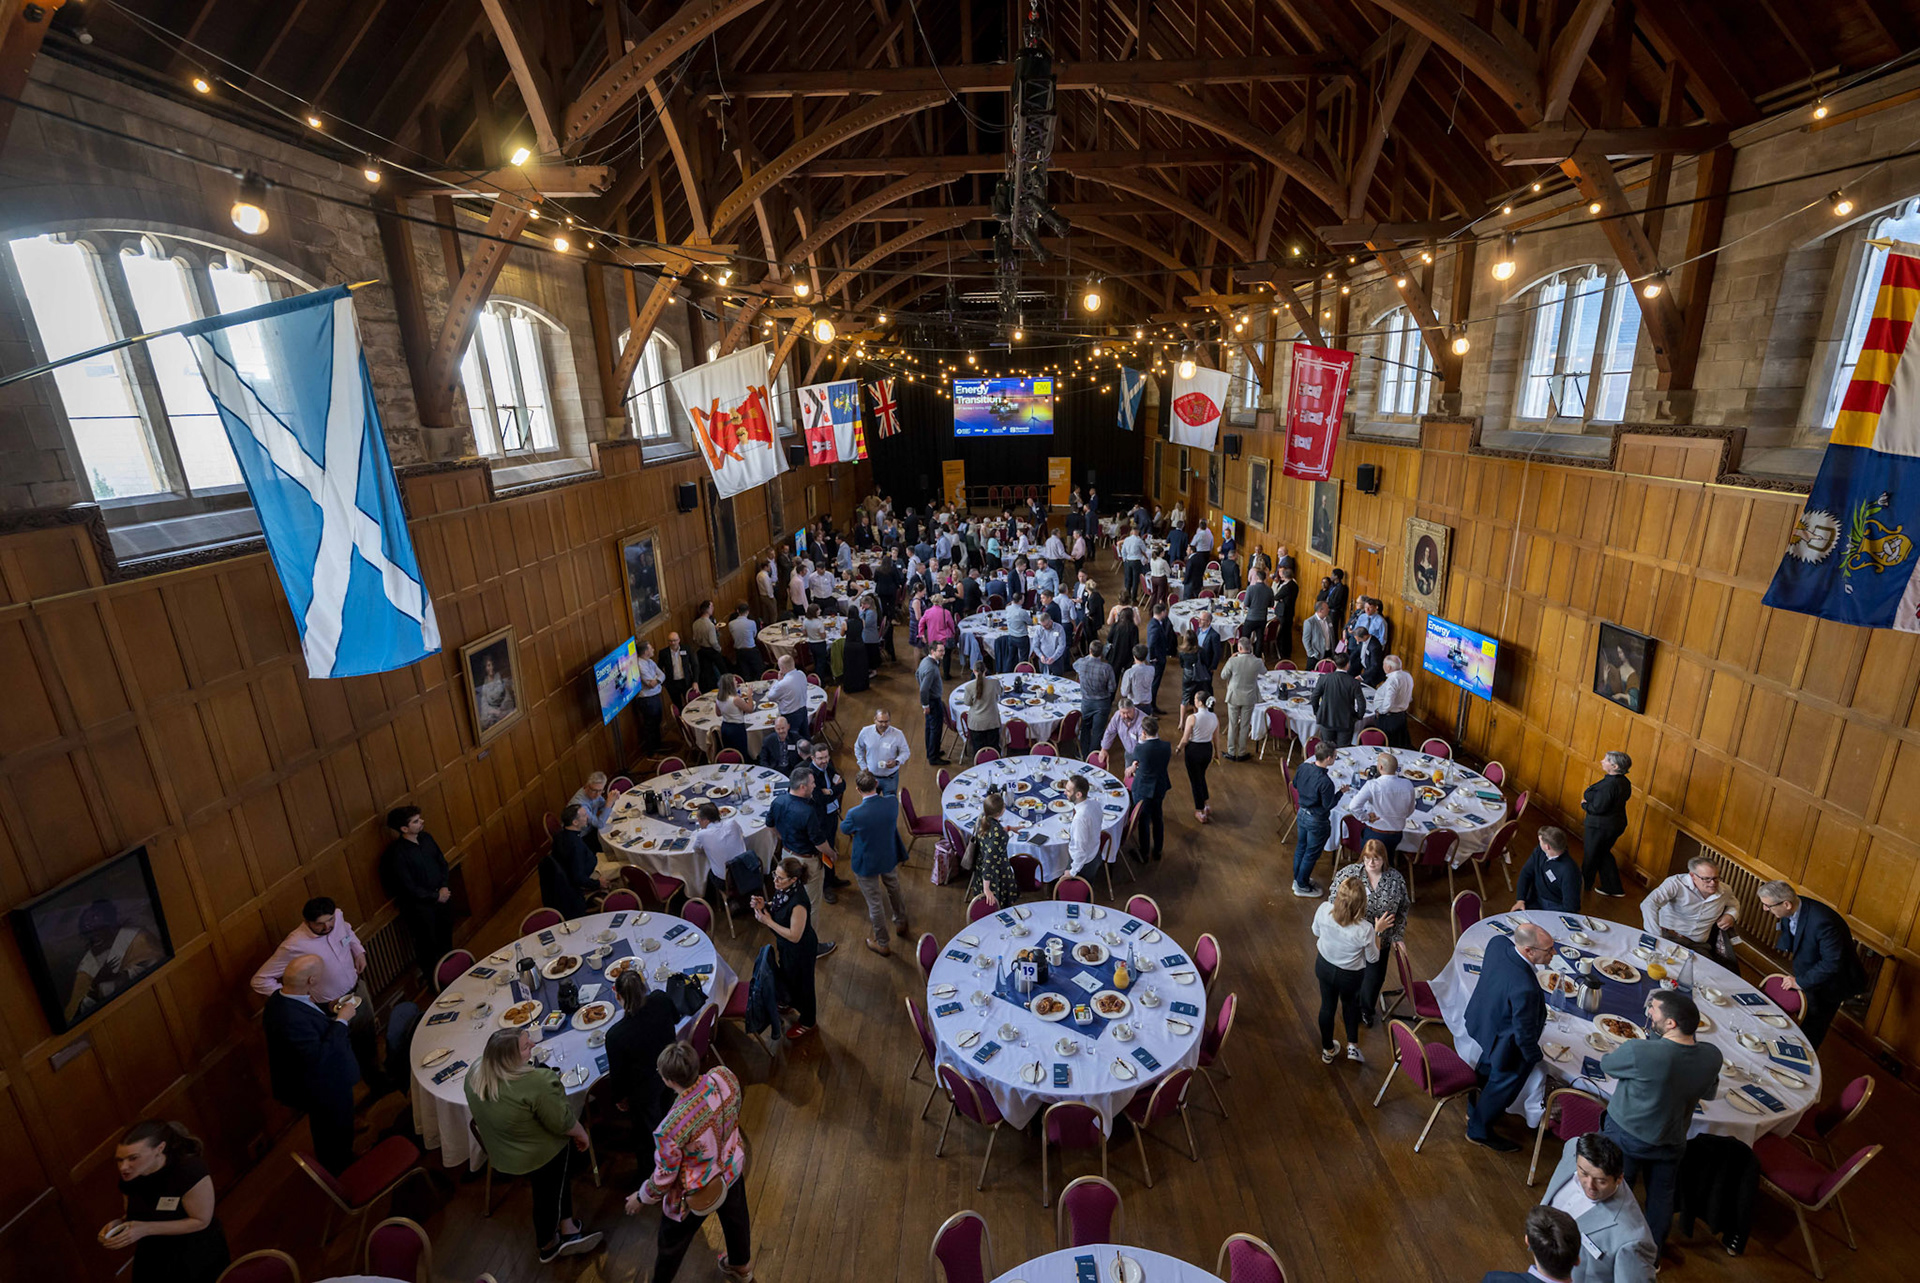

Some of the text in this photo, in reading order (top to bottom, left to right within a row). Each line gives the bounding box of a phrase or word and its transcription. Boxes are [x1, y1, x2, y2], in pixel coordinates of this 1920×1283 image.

[955, 385, 989, 395] Energy
[956, 395, 1002, 405] Transition
[1427, 620, 1450, 637] Energy
[596, 663, 612, 680] Energy
[1023, 966, 1035, 976] 19
